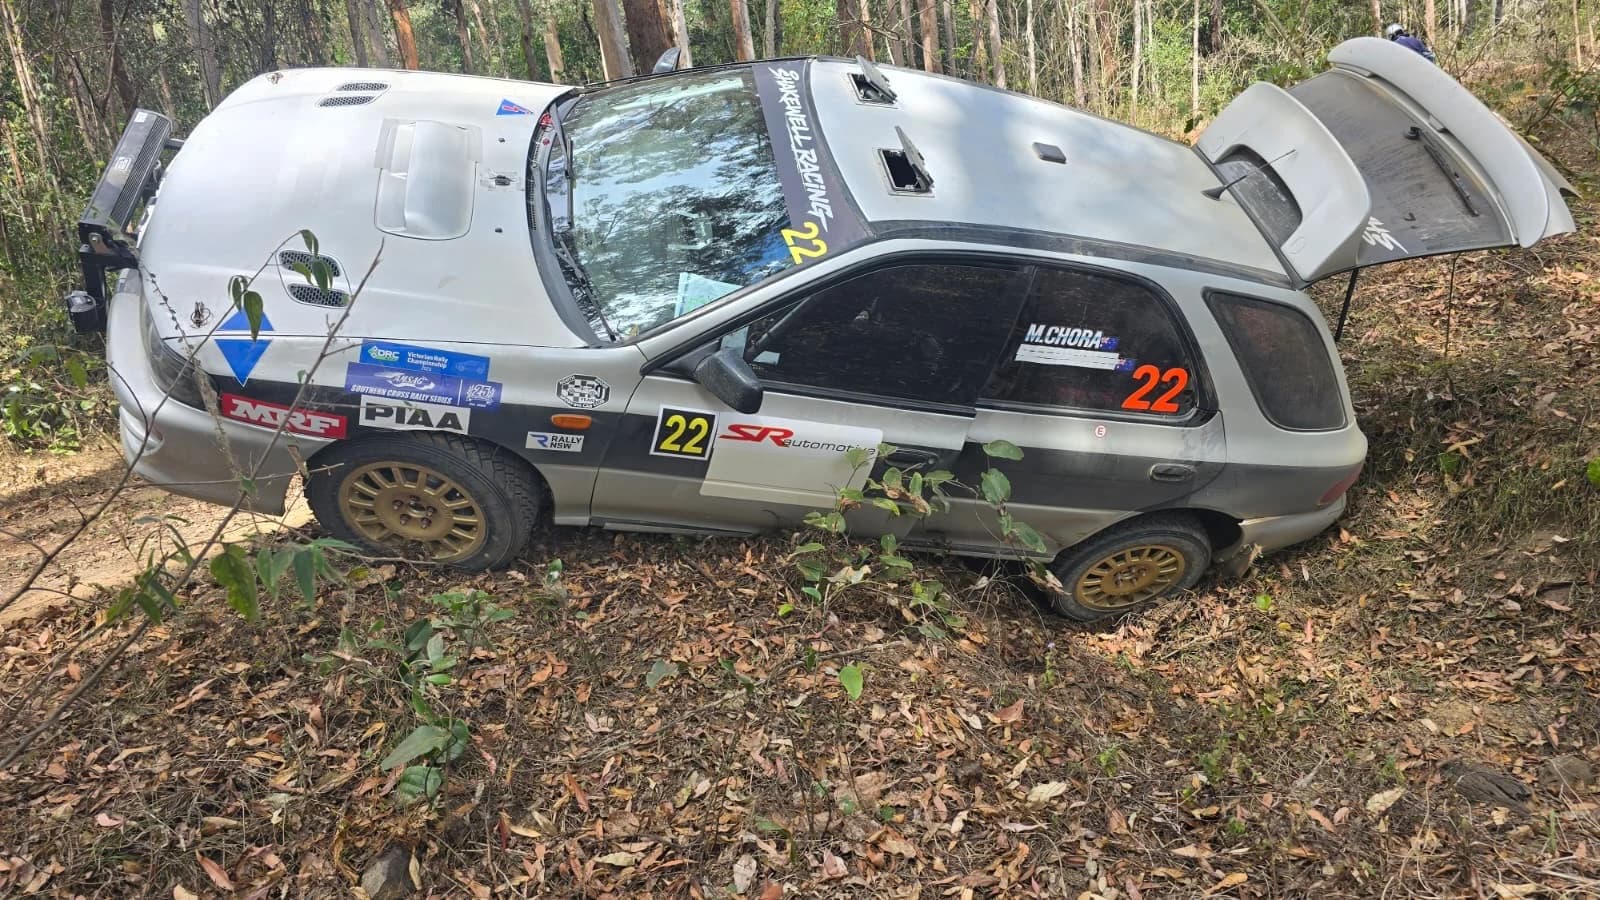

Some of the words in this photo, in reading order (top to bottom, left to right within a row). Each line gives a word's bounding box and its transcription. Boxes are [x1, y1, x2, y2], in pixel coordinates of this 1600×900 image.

[781, 221, 828, 265] 22
[1024, 324, 1104, 349] M.CHORA
[350, 384, 389, 395] SOUTHERN
[387, 389, 410, 399] CROSS
[409, 392, 430, 401] RALLY
[429, 394, 453, 404] SERIES
[472, 384, 491, 397] 25
[1121, 364, 1189, 413] 22
[230, 398, 339, 433] MRF
[365, 402, 463, 431] PIAA
[551, 435, 582, 444] RALLY
[659, 414, 709, 454] 22
[719, 423, 794, 448] SR
[783, 438, 876, 455] automote
